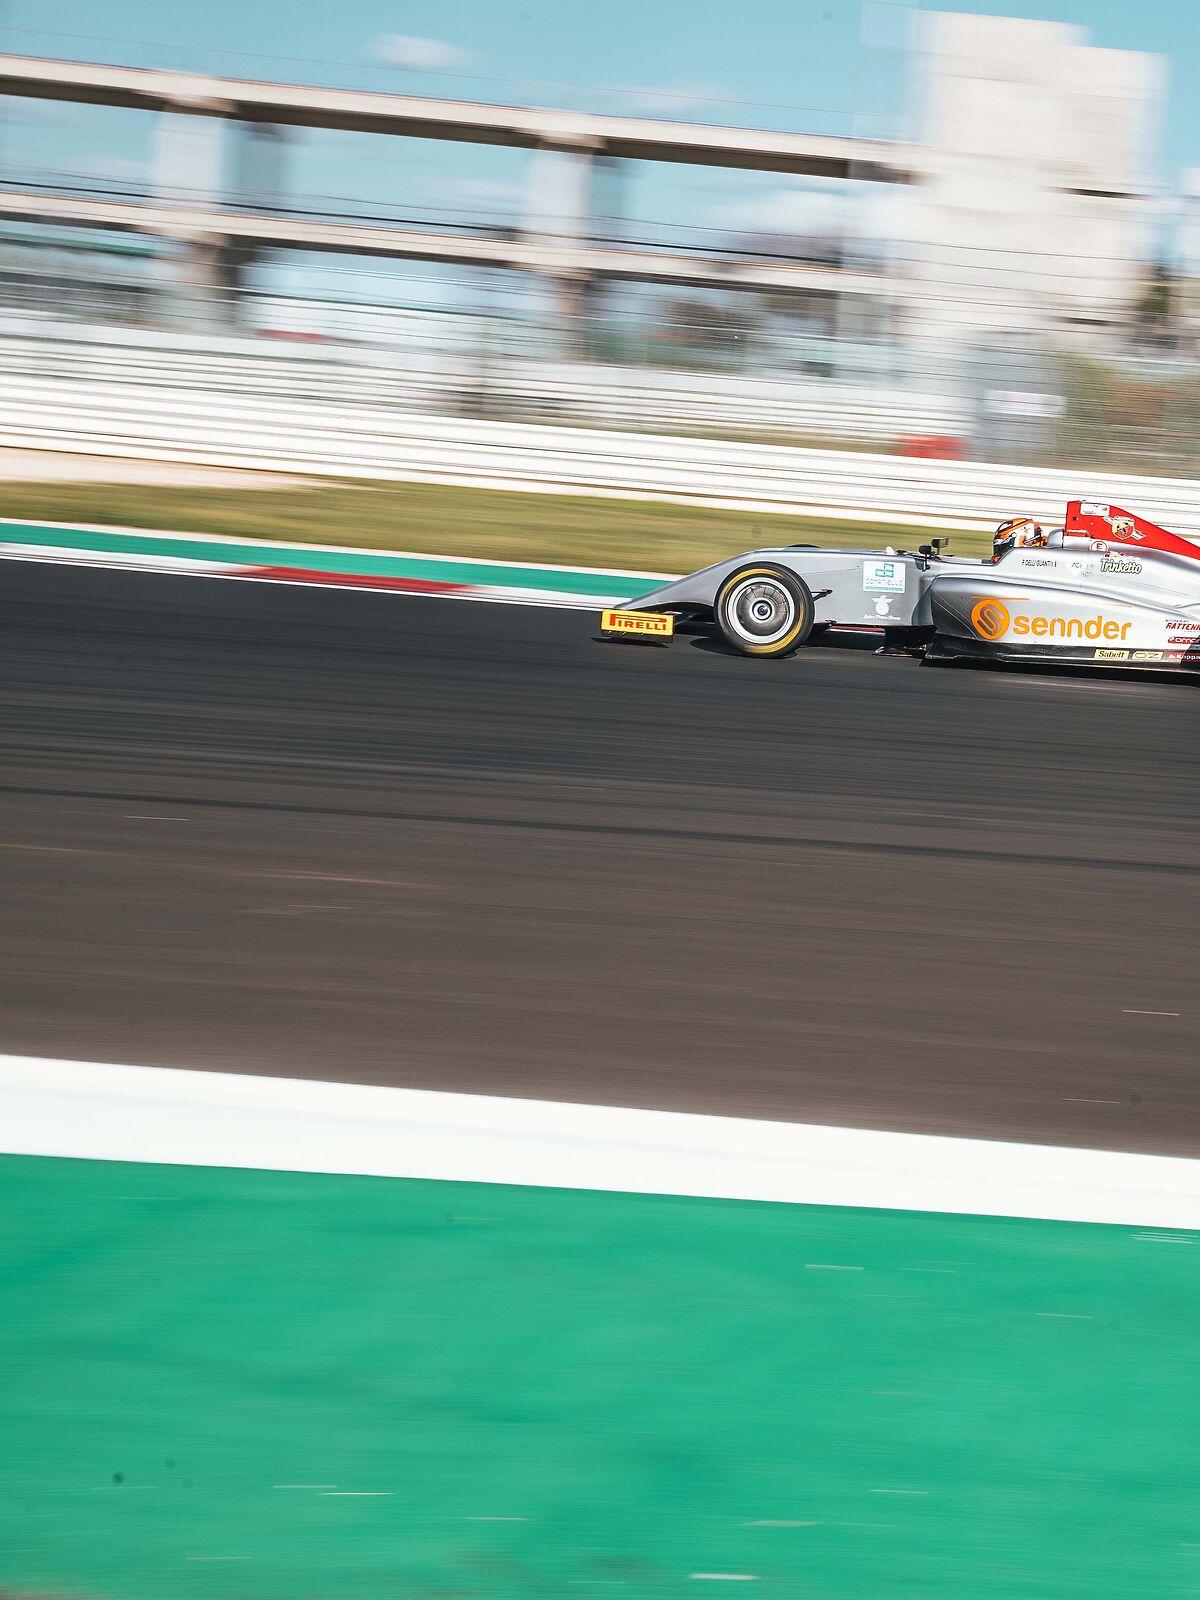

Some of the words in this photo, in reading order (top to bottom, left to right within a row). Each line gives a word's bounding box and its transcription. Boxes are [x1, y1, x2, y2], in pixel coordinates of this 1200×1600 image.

[1100, 557, 1143, 575] Trinketto
[609, 613, 667, 631] PIRELLI
[1012, 615, 1132, 640] sennder
